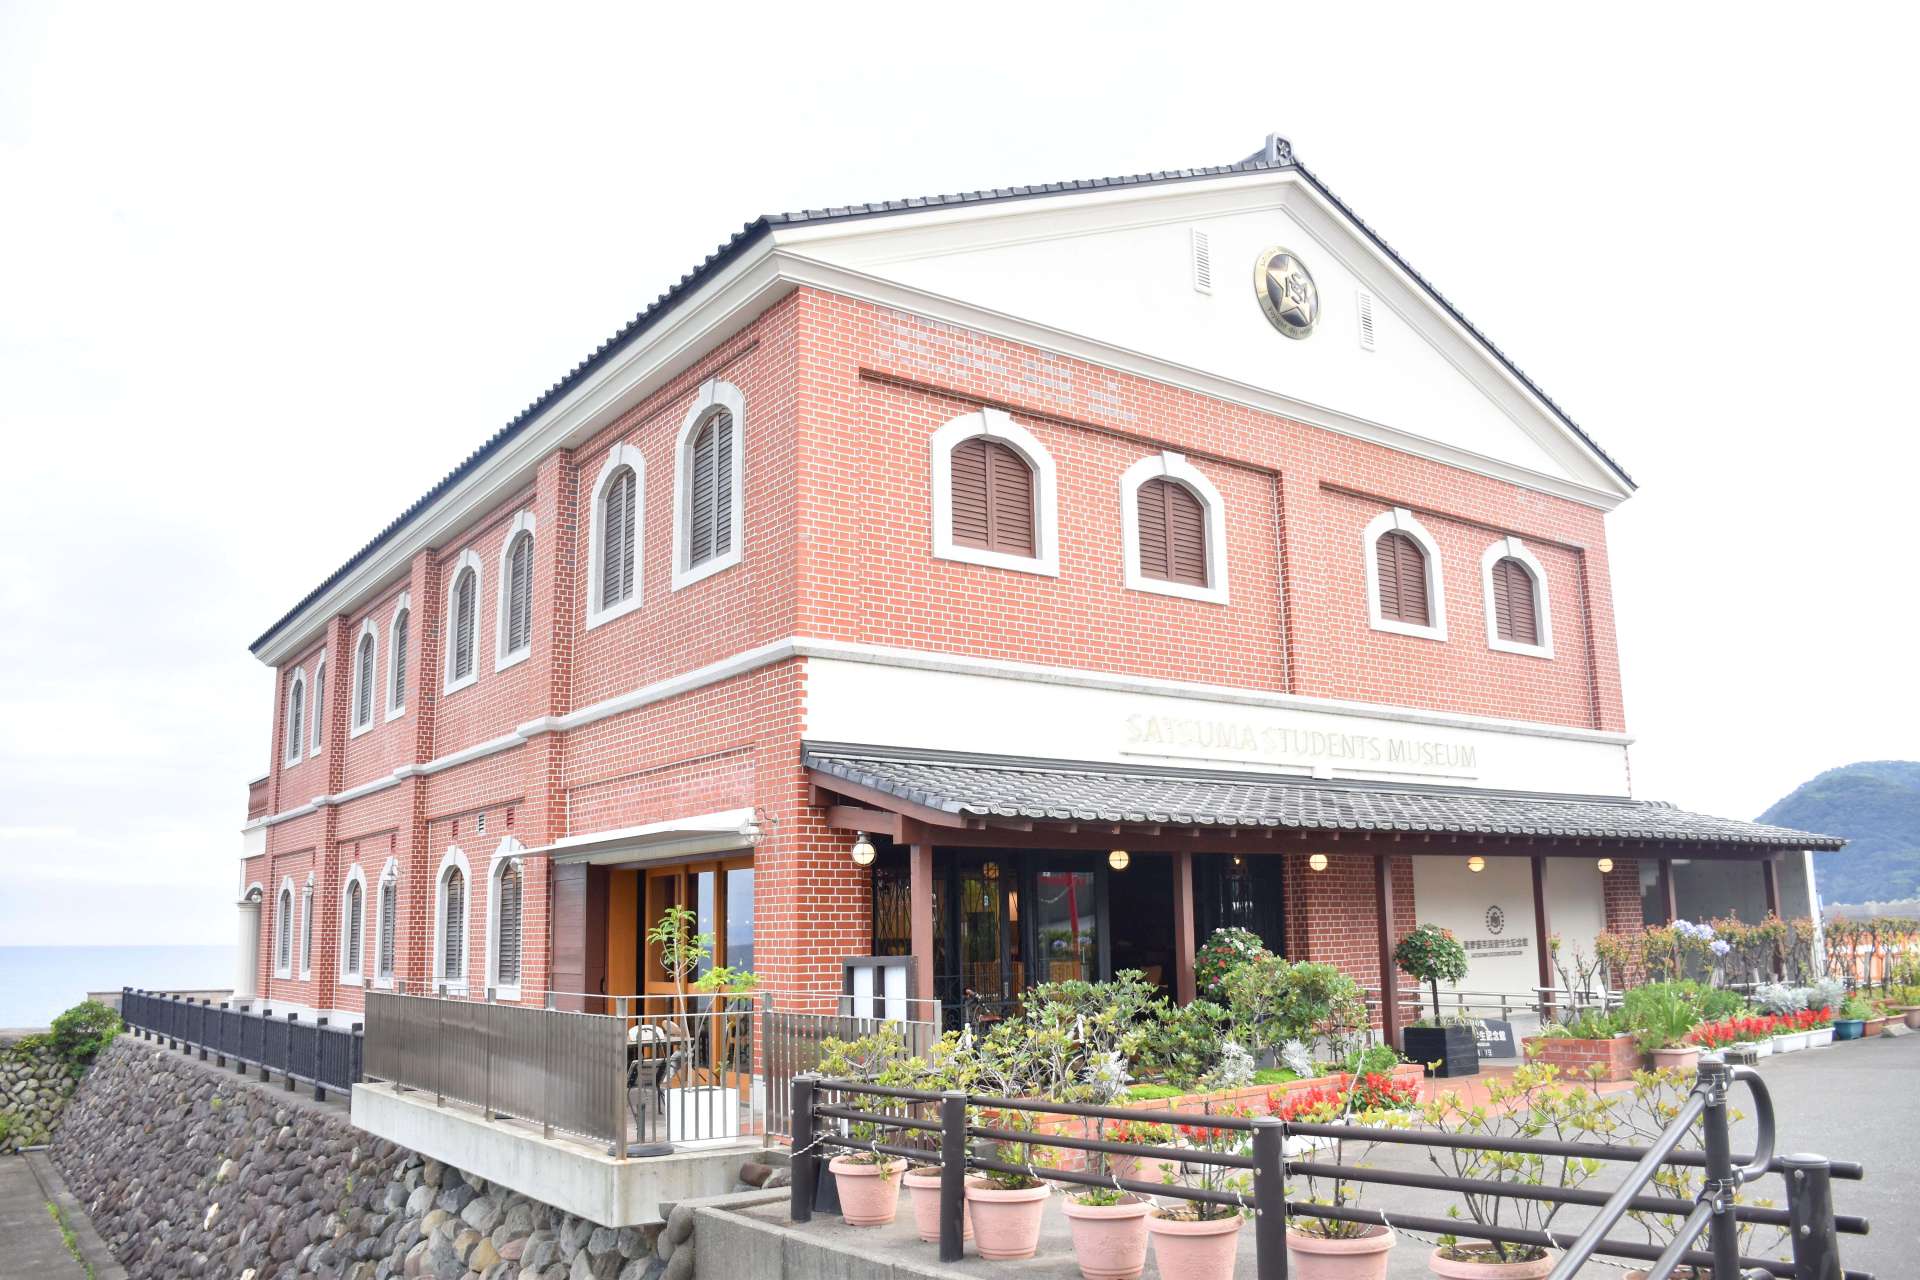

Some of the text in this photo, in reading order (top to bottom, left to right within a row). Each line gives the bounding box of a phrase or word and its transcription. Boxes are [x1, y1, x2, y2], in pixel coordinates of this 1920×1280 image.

[1125, 714, 1477, 768] SATSUMA STUDENTS MUSEUM
